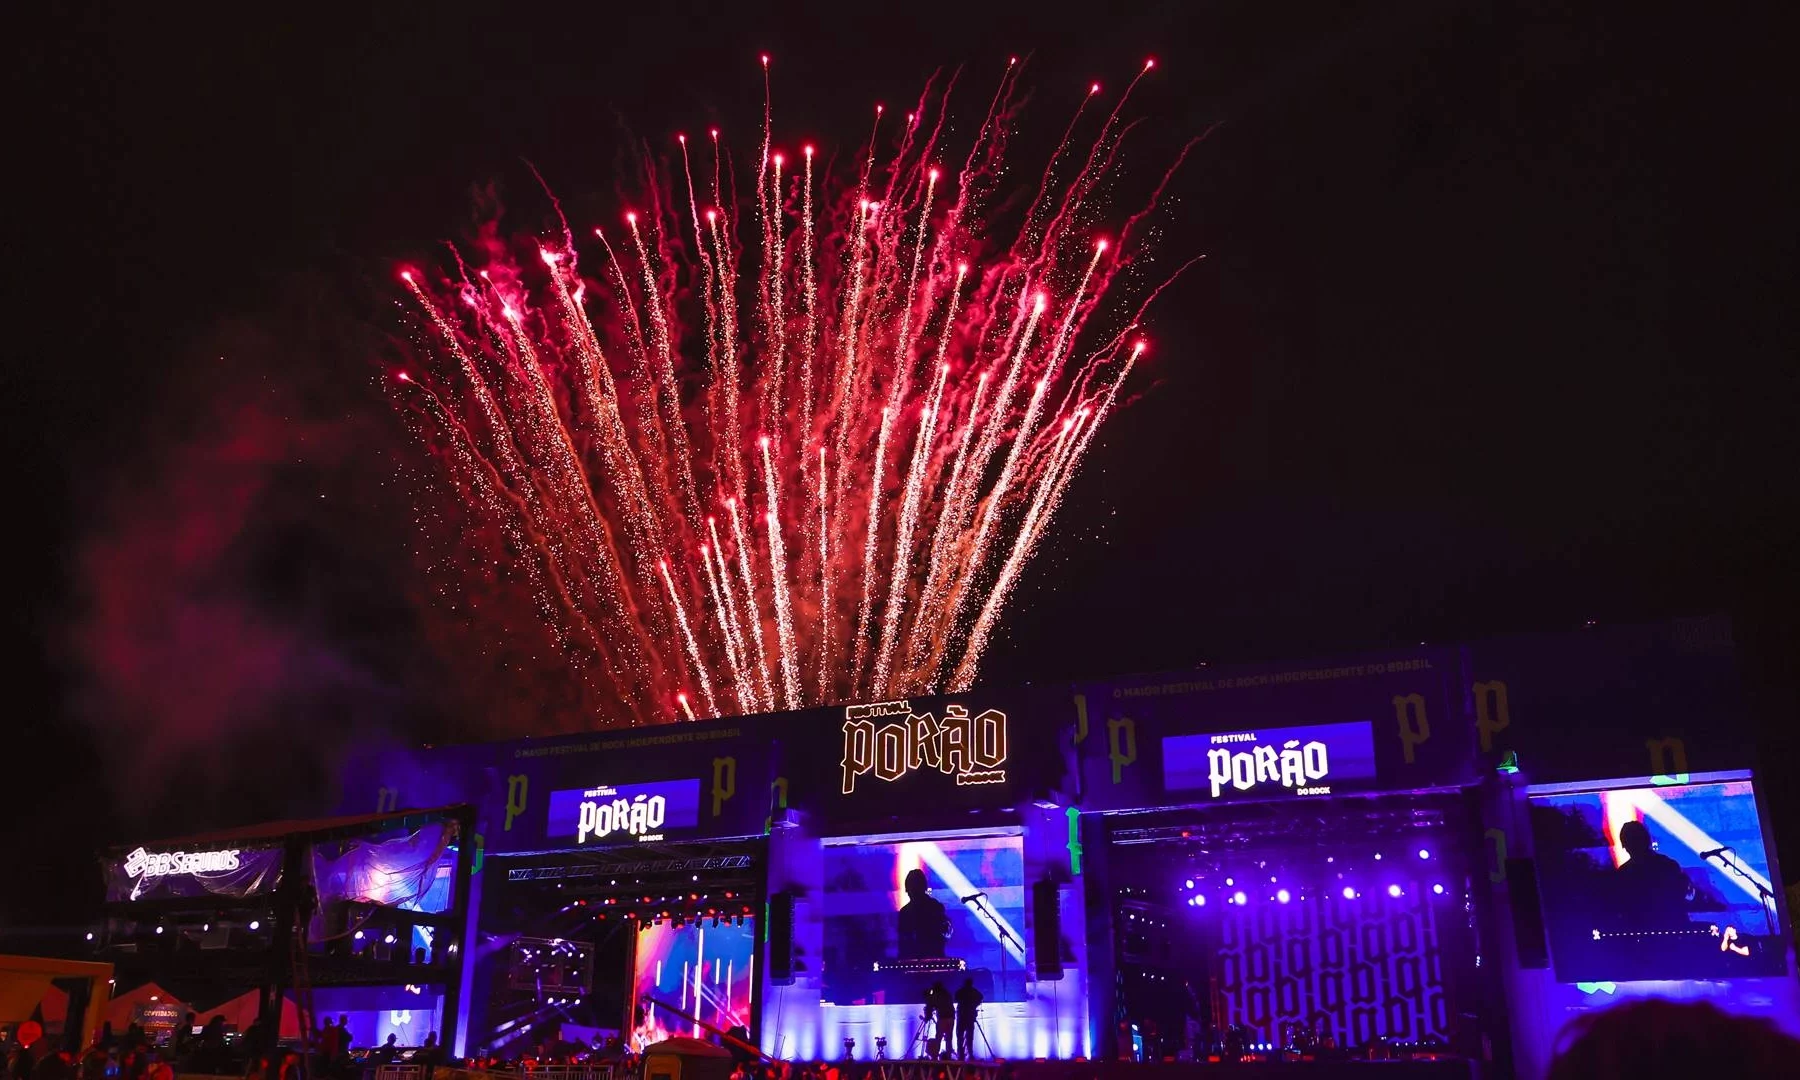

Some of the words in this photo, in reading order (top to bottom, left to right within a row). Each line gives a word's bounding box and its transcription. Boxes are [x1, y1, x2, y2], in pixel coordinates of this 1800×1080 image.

[1113, 688, 1121, 698] O
[1123, 685, 1160, 697] MAIOR
[1162, 680, 1215, 694] FESTIVAL
[1218, 679, 1235, 689] DE
[1236, 676, 1267, 687] ROCK
[1271, 665, 1364, 684] INDEPENDENTE
[1368, 663, 1385, 674] DO
[1387, 658, 1433, 673] BRASIL
[840, 705, 1006, 794] PORÃO
[1211, 733, 1257, 744] FESTIVAL
[1207, 740, 1328, 797] PORÃO
[1297, 788, 1309, 796] DO
[1309, 786, 1331, 795] ROCK
[578, 794, 665, 844] PORÃO
